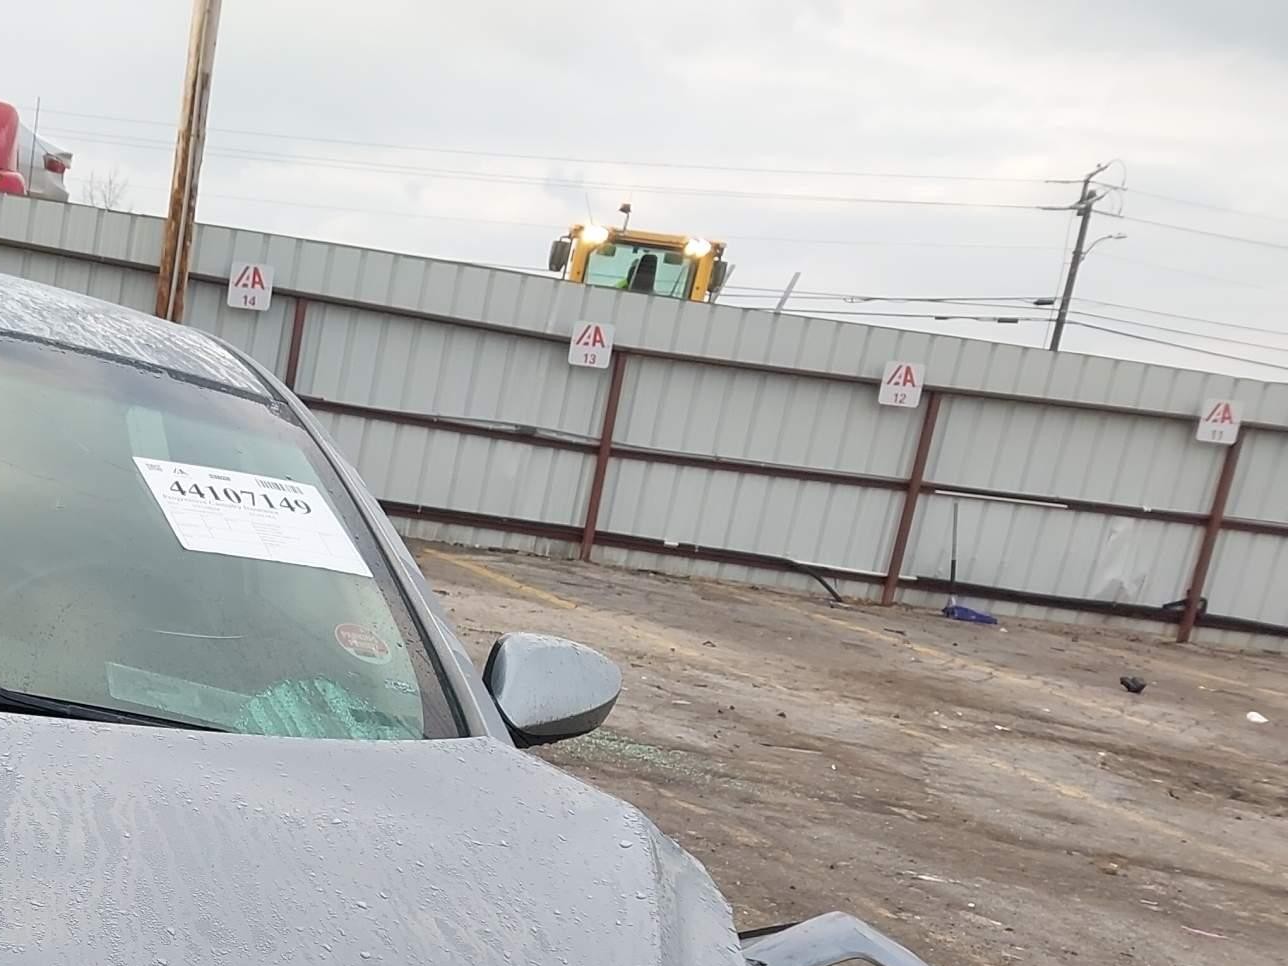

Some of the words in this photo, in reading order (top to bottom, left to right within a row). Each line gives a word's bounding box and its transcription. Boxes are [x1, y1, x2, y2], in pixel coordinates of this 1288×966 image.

[243, 294, 256, 307] 14
[583, 353, 597, 365] 13
[893, 392, 907, 405] 12
[169, 480, 312, 515] 44107149
